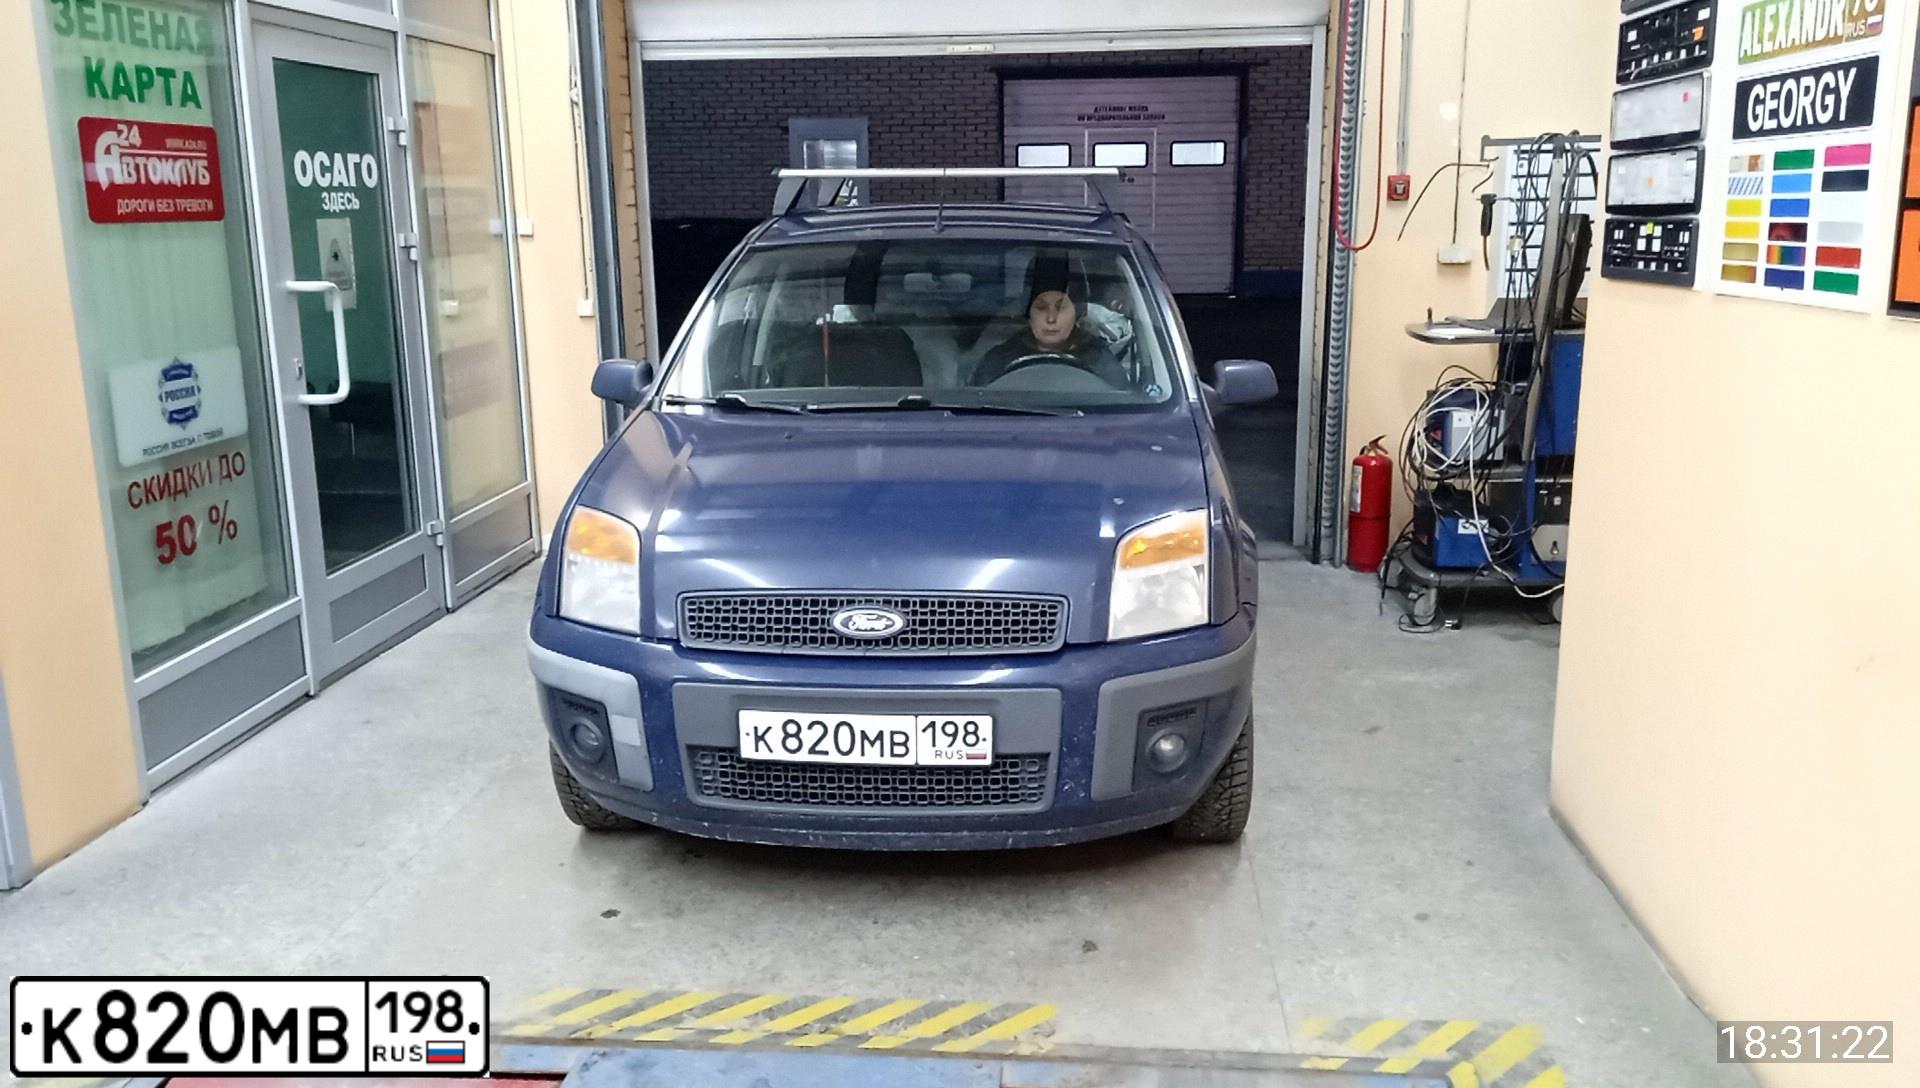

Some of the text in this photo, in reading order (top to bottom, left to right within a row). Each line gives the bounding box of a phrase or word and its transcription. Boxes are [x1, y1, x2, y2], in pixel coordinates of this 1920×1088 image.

[53, 0, 214, 56] ЗЕЛЕНАЯ
[84, 56, 202, 109] КАРТА
[1747, 66, 1857, 132] GEORGY
[116, 124, 143, 147] 24
[293, 150, 378, 188] ОСАГО
[116, 198, 214, 216] ДОРОГИ БЕЗ ТРЕВОГИ
[321, 191, 360, 211] ЗДЕСЬ
[127, 451, 246, 510] СКИДКИ ДО
[154, 499, 238, 566] 50 %
[753, 718, 980, 759] К820МВ 198
[934, 749, 964, 761] RUS
